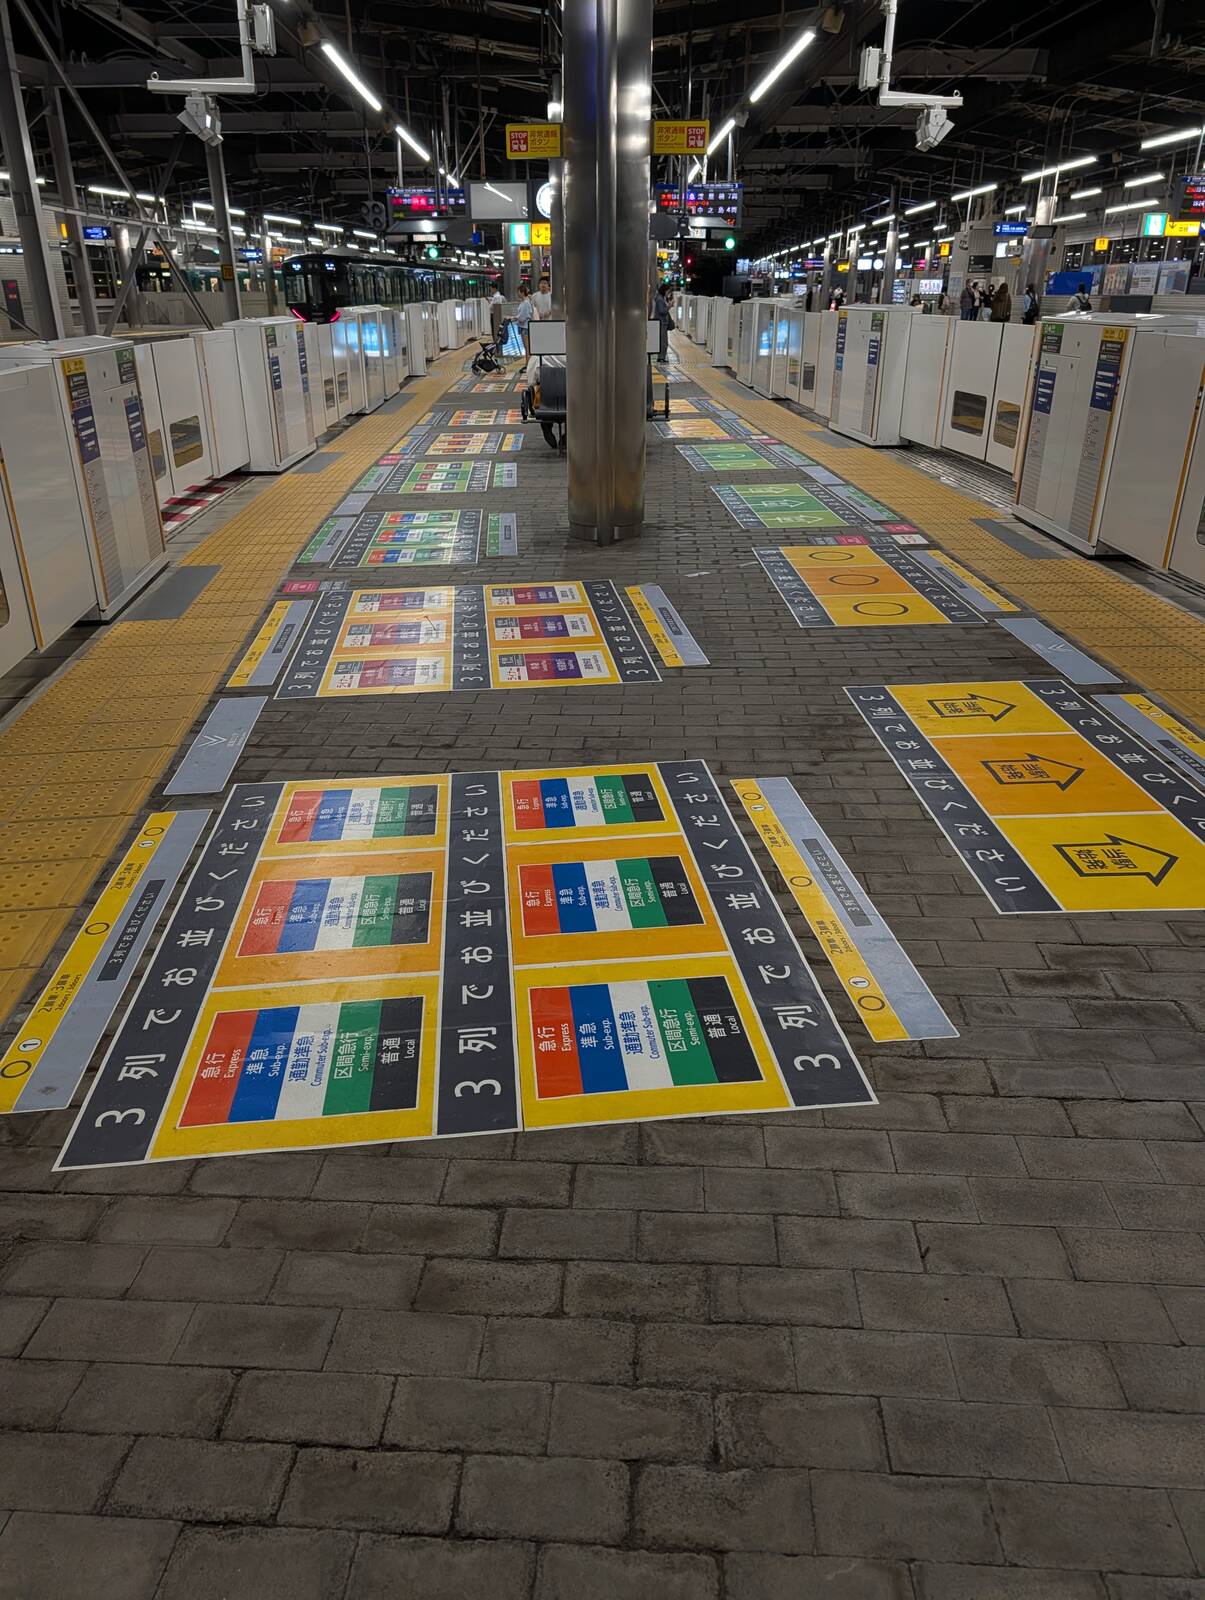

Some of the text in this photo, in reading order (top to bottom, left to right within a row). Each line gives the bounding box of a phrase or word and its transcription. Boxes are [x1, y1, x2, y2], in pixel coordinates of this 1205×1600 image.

[517, 798, 529, 810] 急行
[545, 796, 557, 808] 準急
[600, 789, 616, 809] 区間急行
[630, 791, 644, 802] 普通
[859, 694, 1027, 892] 3列でお並びください
[1074, 849, 1109, 869] 始発
[1101, 848, 1137, 870] 当駅
[526, 891, 540, 907] 急行
[544, 889, 552, 906] Express
[559, 888, 573, 904] 準急
[578, 885, 587, 906] Sub-exp.
[592, 880, 610, 909] 通勤準急
[624, 878, 644, 907] 区間急行
[644, 880, 656, 903] Semi-exp.
[660, 882, 677, 897] 普通
[677, 883, 689, 894] Local
[253, 905, 274, 926] 急行
[289, 906, 307, 922] 準急
[361, 895, 380, 924] 区間急行
[398, 899, 415, 914] 普通
[110, 892, 154, 964] 3列でお並びください
[677, 772, 841, 1070] 3列でお並びください
[454, 784, 501, 1098] 3列でお並びください
[95, 795, 264, 1128] 3列でお並びください
[561, 1024, 572, 1051] Express
[579, 1022, 598, 1048] 準急
[602, 1018, 614, 1050] Sub-exp.
[619, 1011, 643, 1055] 通勤準急
[640, 1005, 661, 1060] Commuter Sub-exp.
[661, 1008, 687, 1052] 区間急行
[685, 1010, 700, 1045] Semi-exp.
[703, 1013, 726, 1038] 普通
[725, 1015, 740, 1034] Local
[359, 1032, 374, 1072] Semi-exp.
[381, 1037, 401, 1064] 普通
[404, 1039, 415, 1058] Local
[538, 1026, 557, 1052] 急行
[200, 1052, 225, 1079] 急行
[224, 1048, 241, 1078] Express
[246, 1048, 269, 1074] 準急
[269, 1043, 286, 1077] Sub-exp.
[288, 1032, 315, 1082] 通勤準急
[311, 1024, 332, 1087] Commuter Sub-exp.
[334, 1032, 359, 1079] 区間急行
